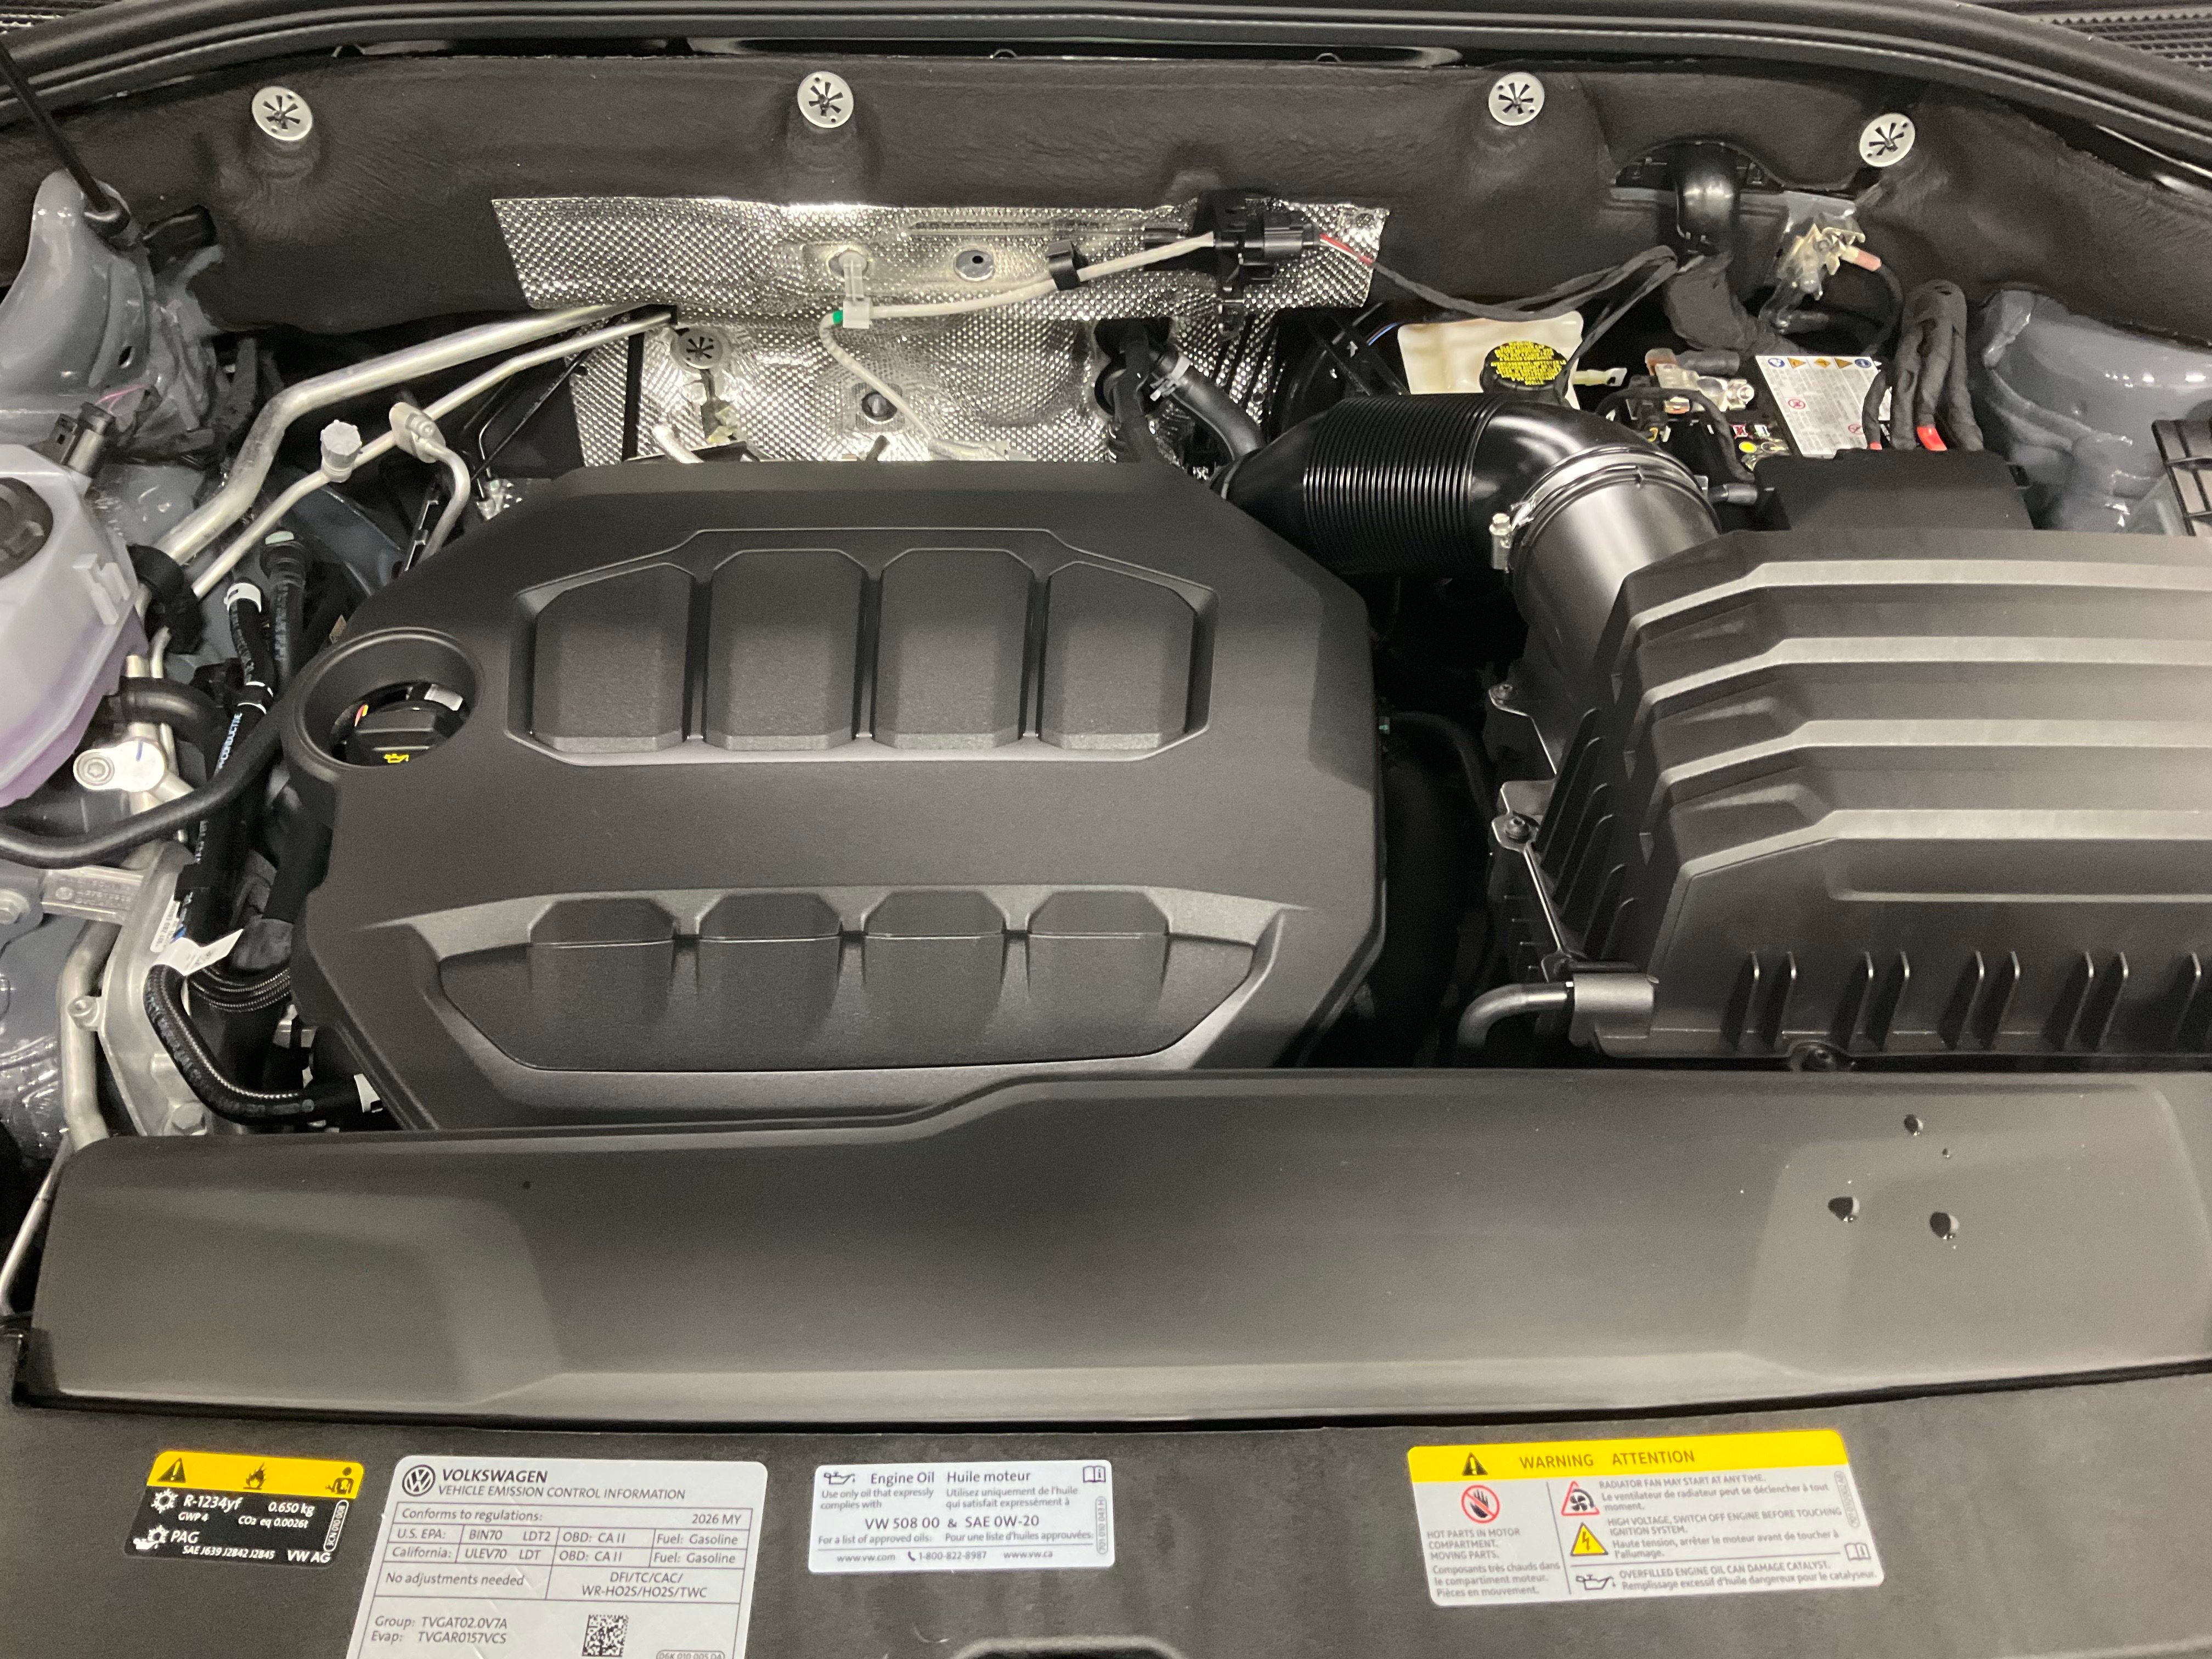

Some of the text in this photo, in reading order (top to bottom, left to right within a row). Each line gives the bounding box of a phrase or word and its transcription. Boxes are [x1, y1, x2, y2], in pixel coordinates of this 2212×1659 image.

[1520, 1451, 1695, 1468] WARNING ATTENTION
[443, 1469, 548, 1483] VOLKSWAGEN
[871, 1472, 934, 1487] Engine Oil
[947, 1471, 1031, 1482] Huile moteur
[1599, 1480, 1642, 1488] RADIATOR
[1683, 1477, 1708, 1485] START
[439, 1486, 685, 1499] VEHICLE EMISSION CONTROL INFORMATION
[840, 1489, 858, 1499] only
[873, 1488, 890, 1497] that
[893, 1488, 933, 1498] expressly
[947, 1488, 979, 1497] Utilisez
[981, 1487, 1035, 1498] uniquement
[1051, 1486, 1077, 1494] l'huile
[1615, 1491, 1661, 1500] ventilateur
[1664, 1490, 1674, 1498] de
[1678, 1489, 1716, 1497] radiateur
[1719, 1488, 1739, 1497] peut
[184, 1494, 315, 1517] R-1234yf 0.650 kg
[821, 1500, 882, 1511] complies with
[946, 1500, 960, 1510] qui
[1000, 1498, 1062, 1509] expressément
[1065, 1496, 1069, 1505] à
[1605, 1503, 1644, 1511] moment.
[178, 1512, 209, 1522] GWP 4
[403, 1509, 542, 1522] Conforms to regulations:
[692, 1514, 741, 1524] 2026 MY
[1608, 1517, 1629, 1526] HIGH
[1631, 1516, 1672, 1525] VOLTAGE,
[1673, 1515, 1707, 1523] SWITCH
[1728, 1511, 1760, 1521] ENGINE
[1762, 1509, 1795, 1519] BEFORE
[1798, 1508, 1842, 1517] TOUCHING
[260, 1519, 272, 1528] eq
[274, 1518, 309, 1528] 0.0026t
[865, 1515, 1039, 1529] VW 508 00 & SAE 0W-20
[398, 1529, 445, 1539] U.S. EPA:
[469, 1530, 550, 1541] BIN70 LDT2
[1488, 1528, 1520, 1536] MOTOR
[1610, 1525, 1688, 1536] IGNITION SYSTEM.
[171, 1531, 199, 1543] PAG
[563, 1532, 591, 1542] OBD:
[599, 1533, 613, 1543] CA
[657, 1534, 738, 1545] Fuel: Gasoline
[819, 1536, 832, 1544] For
[858, 1535, 867, 1543] of
[870, 1533, 911, 1545] approved
[914, 1533, 932, 1542] oils:
[946, 1532, 964, 1542] Pour
[987, 1532, 1003, 1541] liste
[1006, 1531, 1040, 1540] d'huiles
[1429, 1540, 1498, 1549] COMPARTMENT.
[183, 1545, 275, 1560] SAE J639 J2842 J2845
[287, 1550, 331, 1563] VW AG
[393, 1547, 452, 1558] California:
[466, 1549, 541, 1560] ULEV70 LDT
[560, 1551, 588, 1560] OBD:
[595, 1551, 610, 1561] CA
[654, 1552, 735, 1563] Fuel: Gasoline
[837, 1554, 895, 1562] www.vw.com
[919, 1551, 987, 1561] 1-800-822-8987
[1431, 1550, 1499, 1560] MOVING PARTS.
[1433, 1565, 1487, 1575] Composants
[1488, 1564, 1504, 1572] très
[1507, 1562, 1537, 1571] chauds
[1620, 1561, 1830, 1578] OVERFILLED ENGINE OIL CAN DAMAGE CATALYST.
[386, 1573, 524, 1587] No adjustments needed
[610, 1572, 683, 1583] DFI/TC/CAC/
[1446, 1576, 1509, 1586] compartiment
[1512, 1575, 1548, 1583] moteur.
[582, 1585, 707, 1598] WR-HO2S/HO2S/TWC
[1437, 1588, 1465, 1596] Pièces
[1482, 1587, 1539, 1595] mouvement.
[375, 1616, 415, 1629] Group:
[371, 1631, 506, 1644] Evap: TVGAR0157VCS
